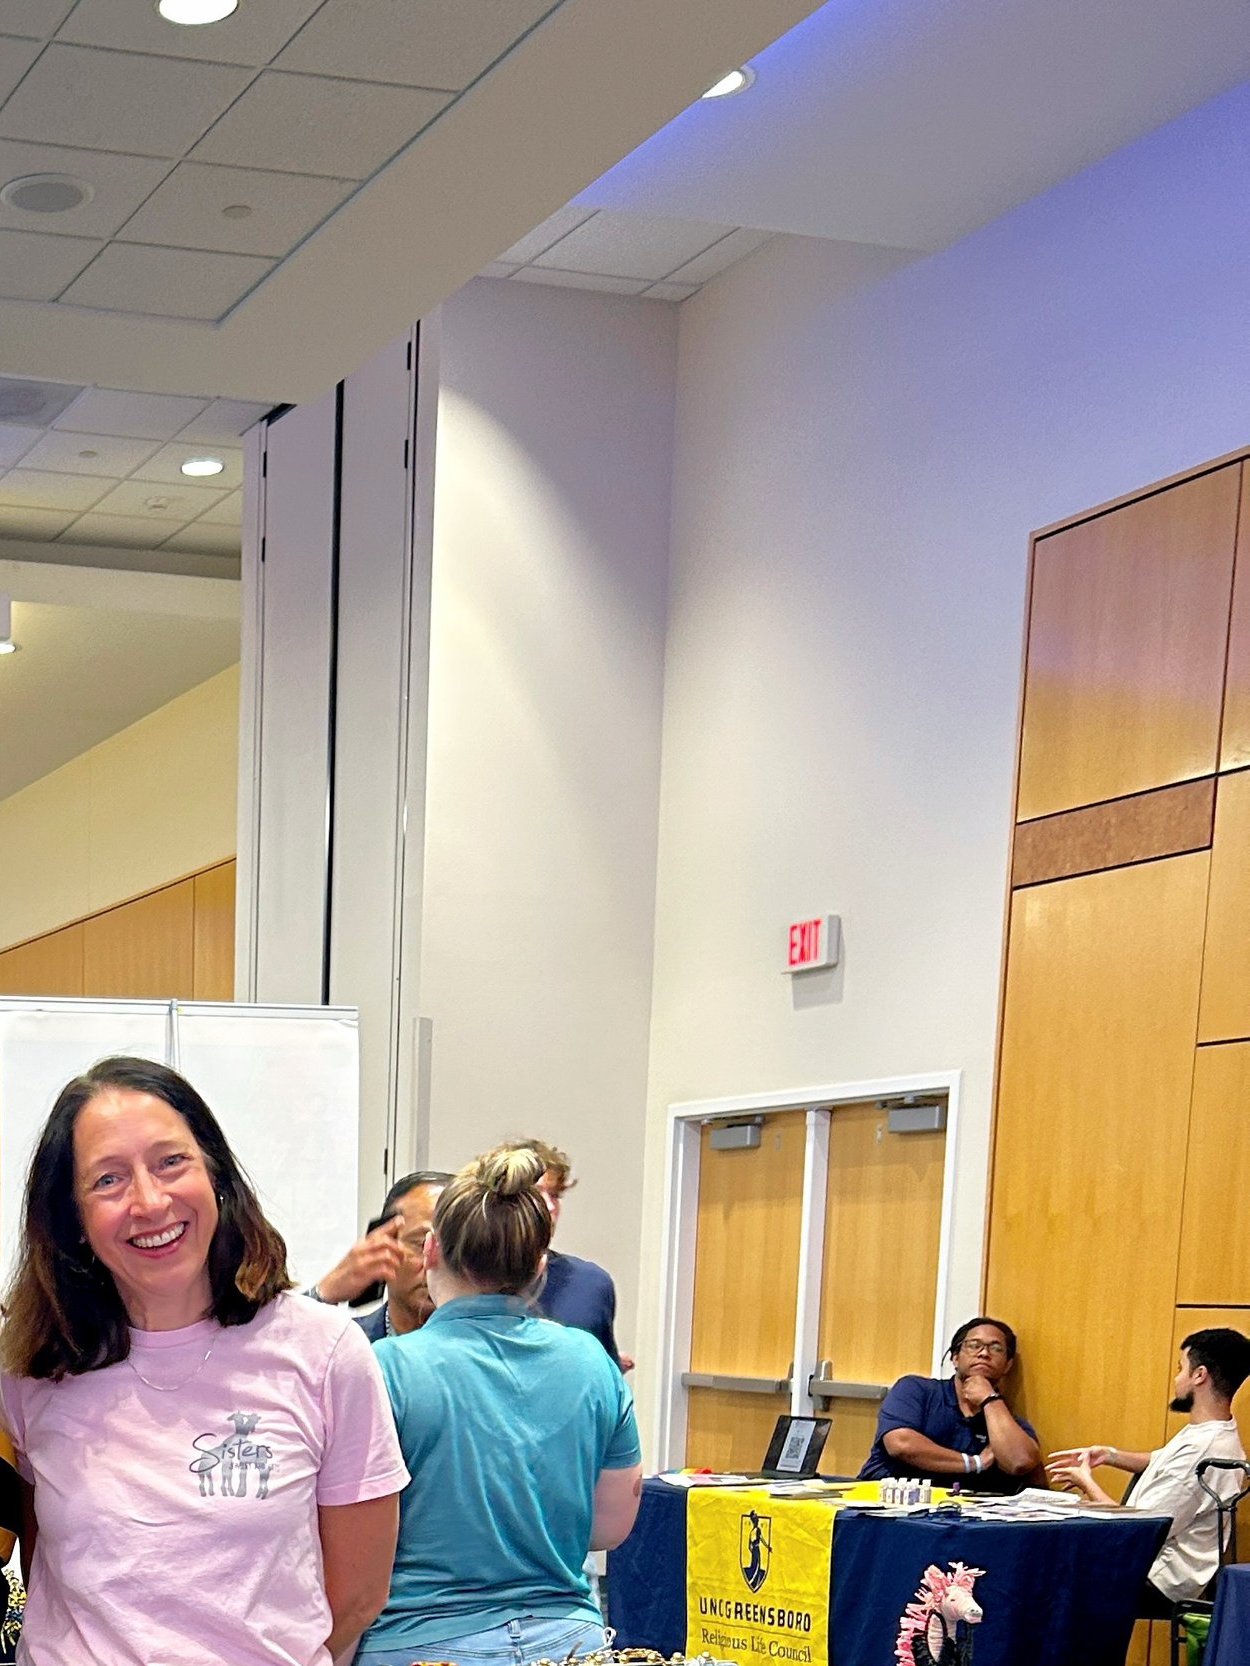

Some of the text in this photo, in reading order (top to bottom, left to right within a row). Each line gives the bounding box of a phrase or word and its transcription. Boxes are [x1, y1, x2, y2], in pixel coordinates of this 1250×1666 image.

[788, 919, 821, 966] EXIT
[189, 1432, 273, 1473] Sisters
[701, 1628, 812, 1664] Religious Life Council
